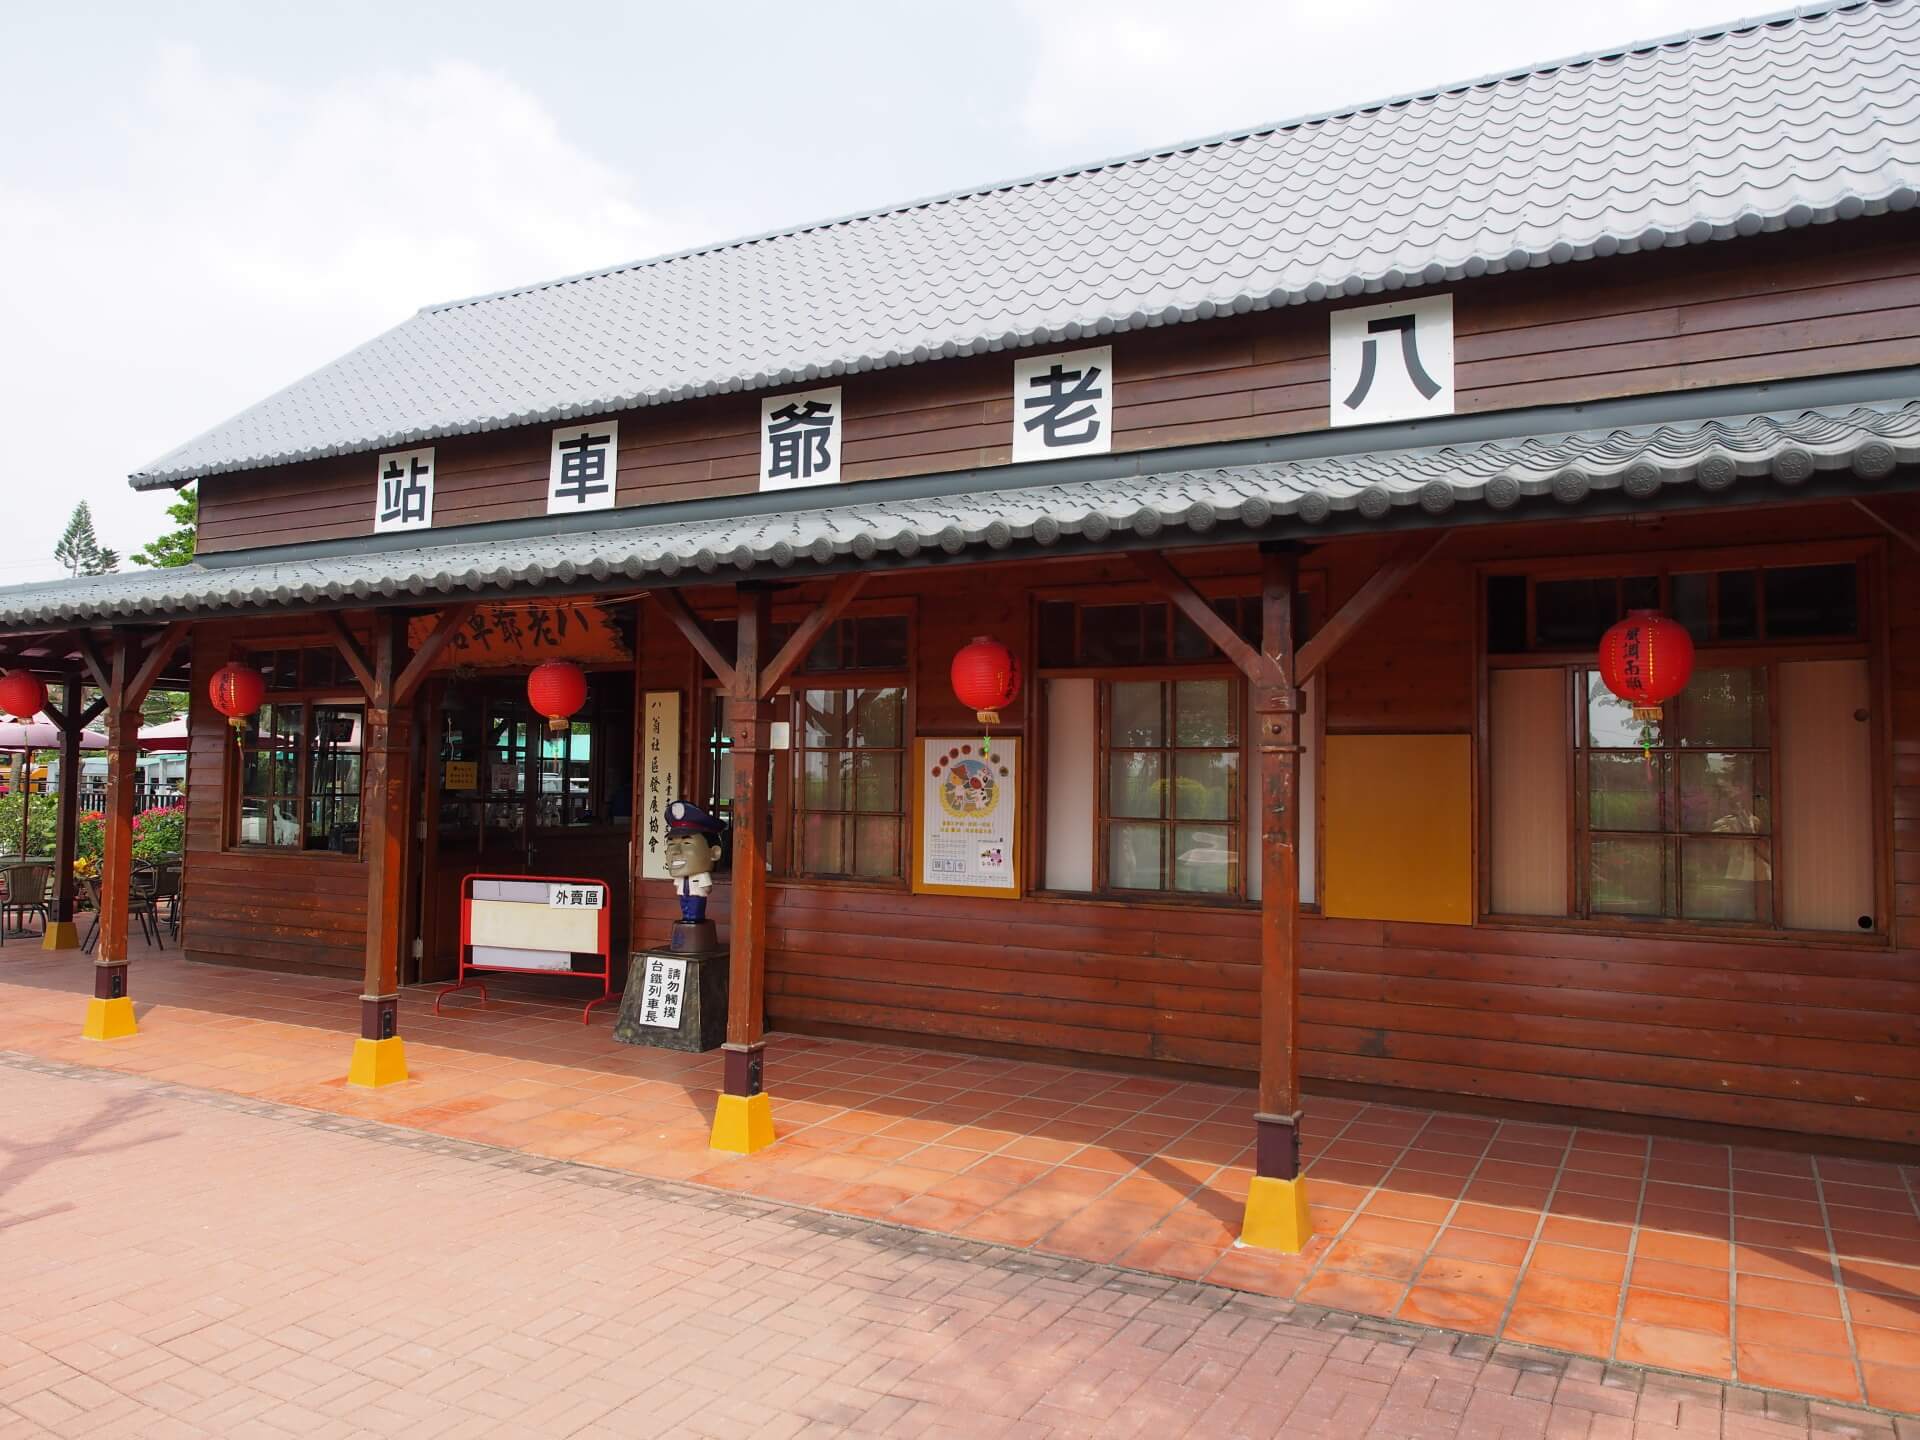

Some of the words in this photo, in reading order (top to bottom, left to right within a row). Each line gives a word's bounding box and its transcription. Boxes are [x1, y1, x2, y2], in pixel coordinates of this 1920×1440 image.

[556, 890, 599, 906] 外賣區
[645, 960, 664, 1022] 台鐵列車長
[663, 967, 681, 1018] 請勿觸摸
